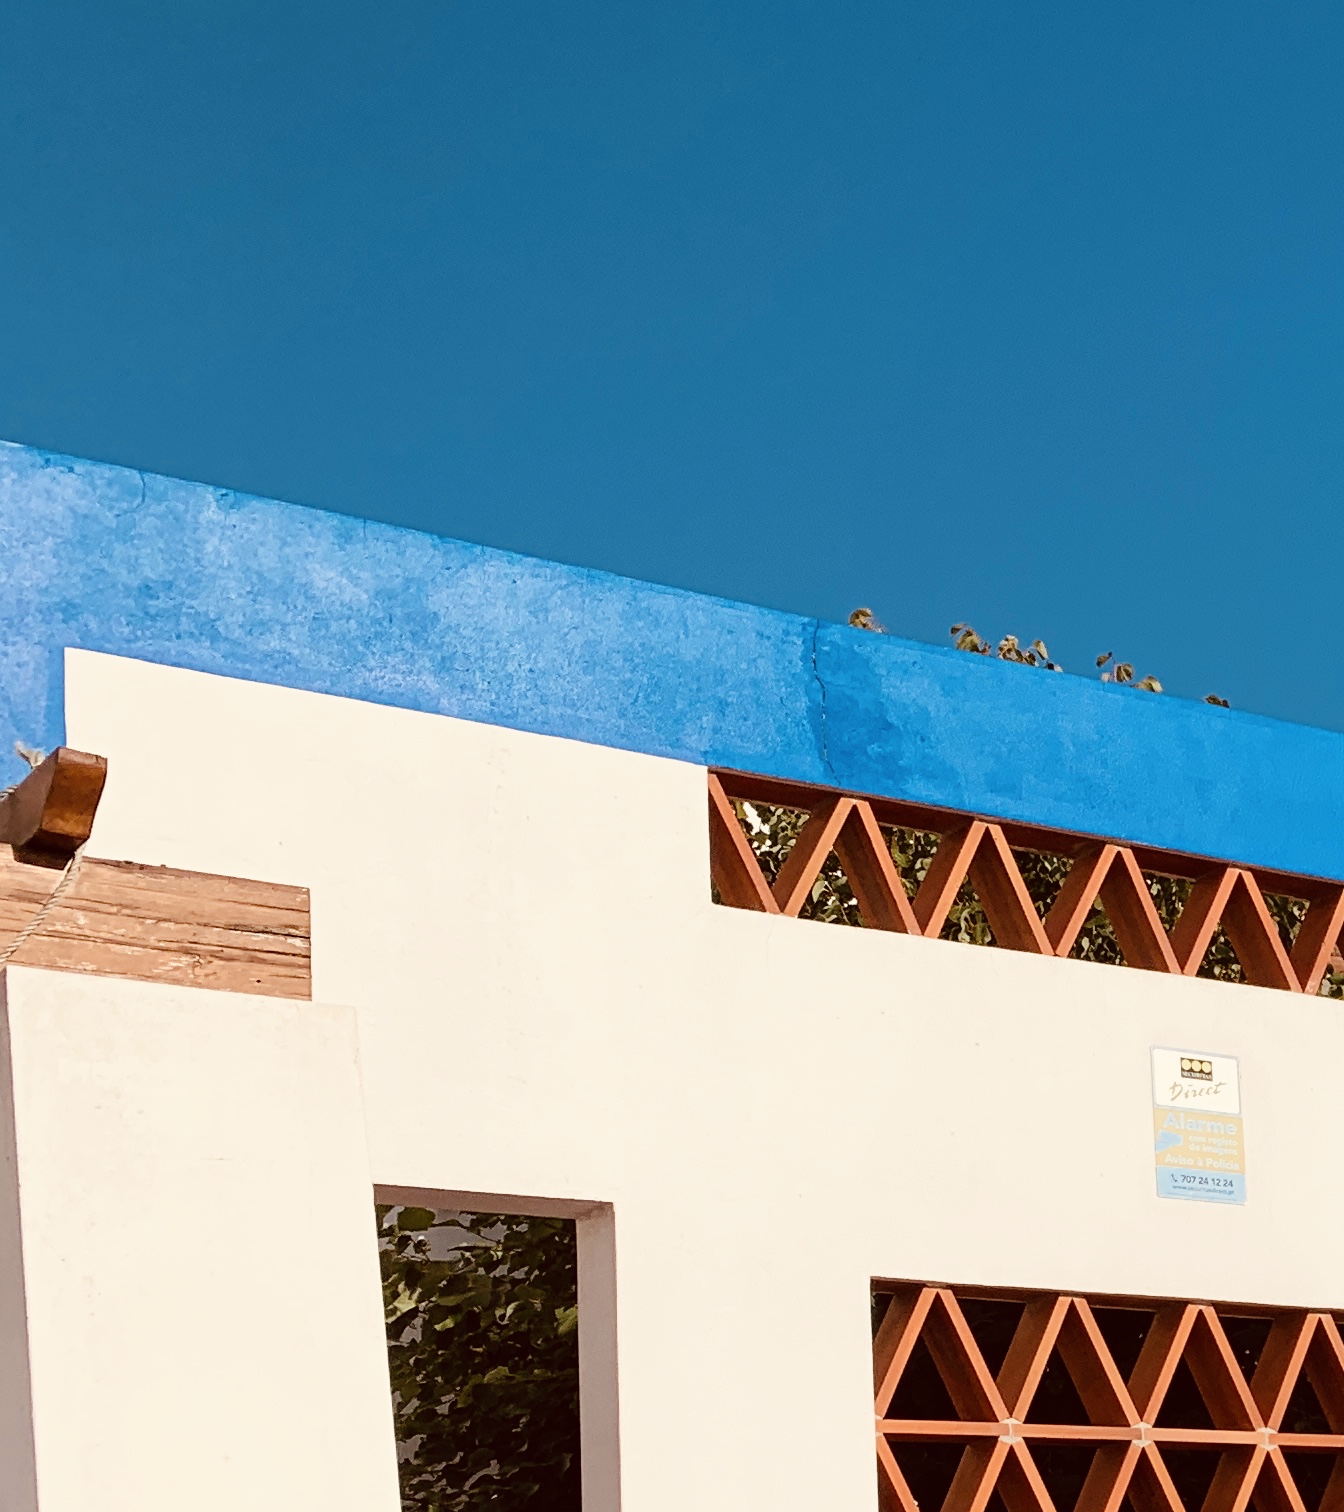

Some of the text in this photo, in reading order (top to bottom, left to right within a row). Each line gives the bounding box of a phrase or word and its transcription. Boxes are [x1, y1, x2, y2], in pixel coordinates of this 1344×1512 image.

[1169, 1081, 1227, 1101] Direct
[1163, 1112, 1237, 1135] Alarme
[1208, 1137, 1238, 1147] registo
[1189, 1143, 1238, 1156] de imagens
[1165, 1153, 1194, 1165] Aviso
[1180, 1174, 1233, 1188] 707 24 12 24
